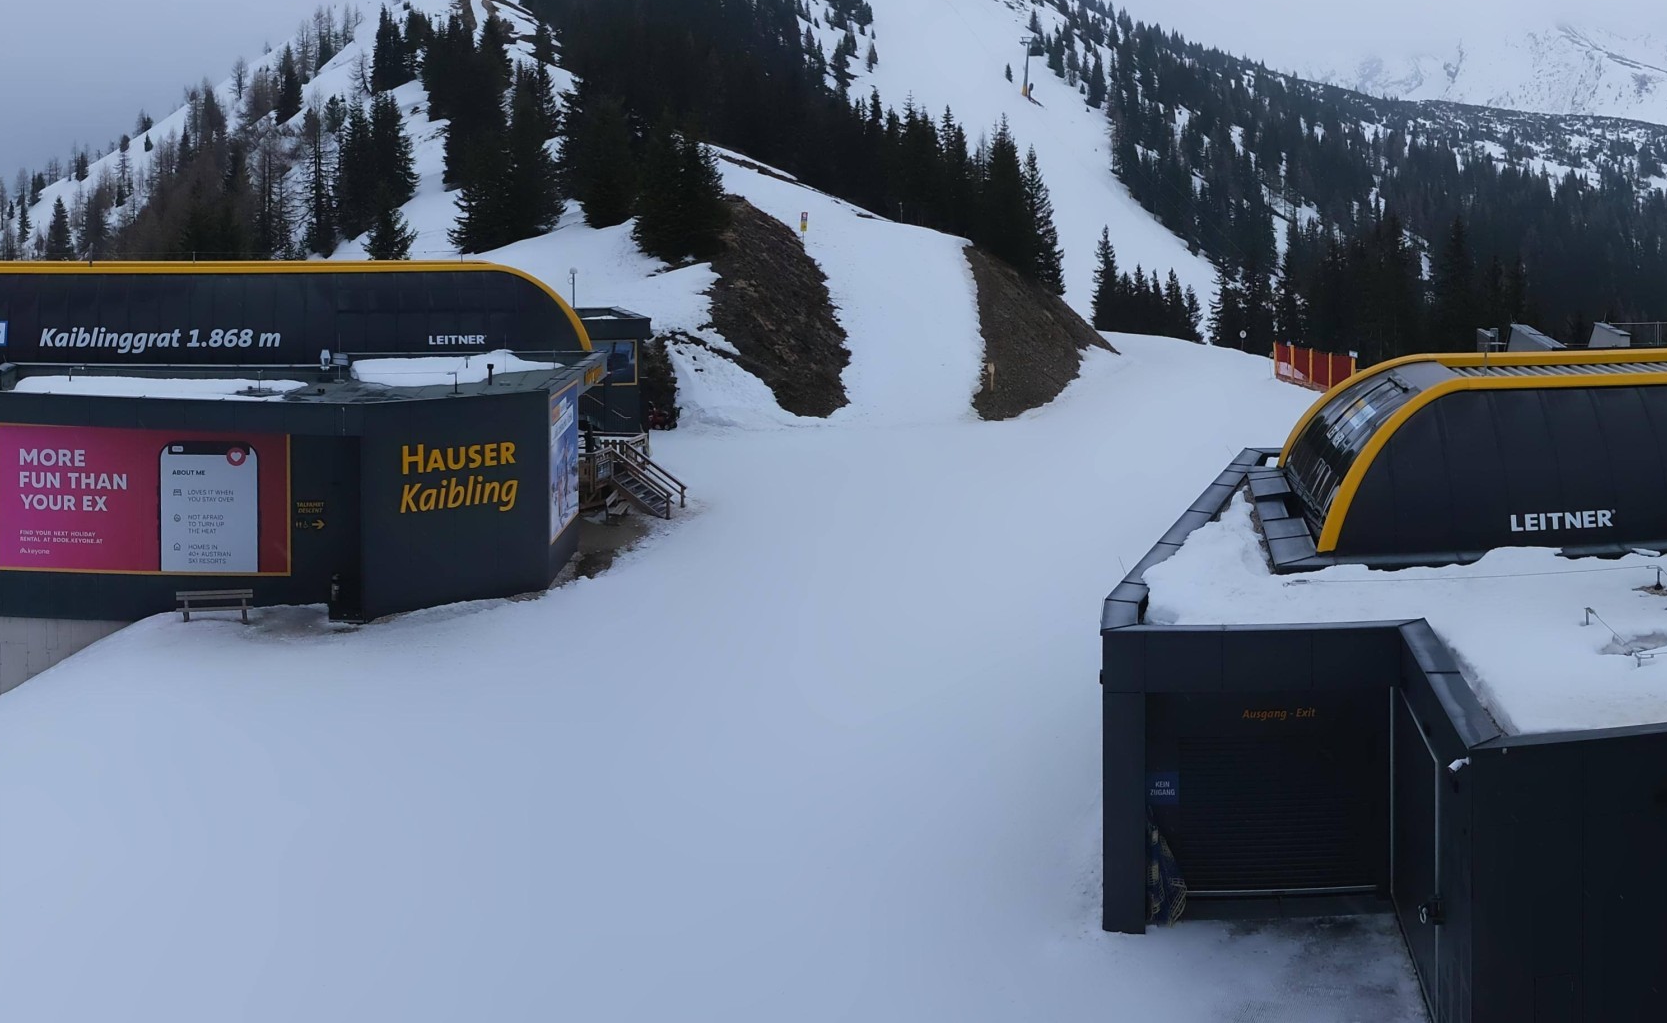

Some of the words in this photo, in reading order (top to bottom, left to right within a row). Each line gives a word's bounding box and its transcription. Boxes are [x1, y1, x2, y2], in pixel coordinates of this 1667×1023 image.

[39, 327, 181, 353] Kaiblinggrat
[186, 328, 253, 348] 1.868
[258, 331, 281, 348] m
[19, 448, 86, 467] MORE
[402, 441, 516, 475] HAUSER
[19, 471, 60, 489] FUN
[67, 473, 127, 490] THAN
[20, 494, 76, 511] YOUR
[82, 495, 108, 512] EX
[400, 475, 519, 514] Kaibling
[1242, 709, 1287, 721] Ausgang
[1296, 707, 1316, 718] Exit
[1150, 788, 1176, 796] ZUGANG
[1155, 780, 1170, 788] KEIN
